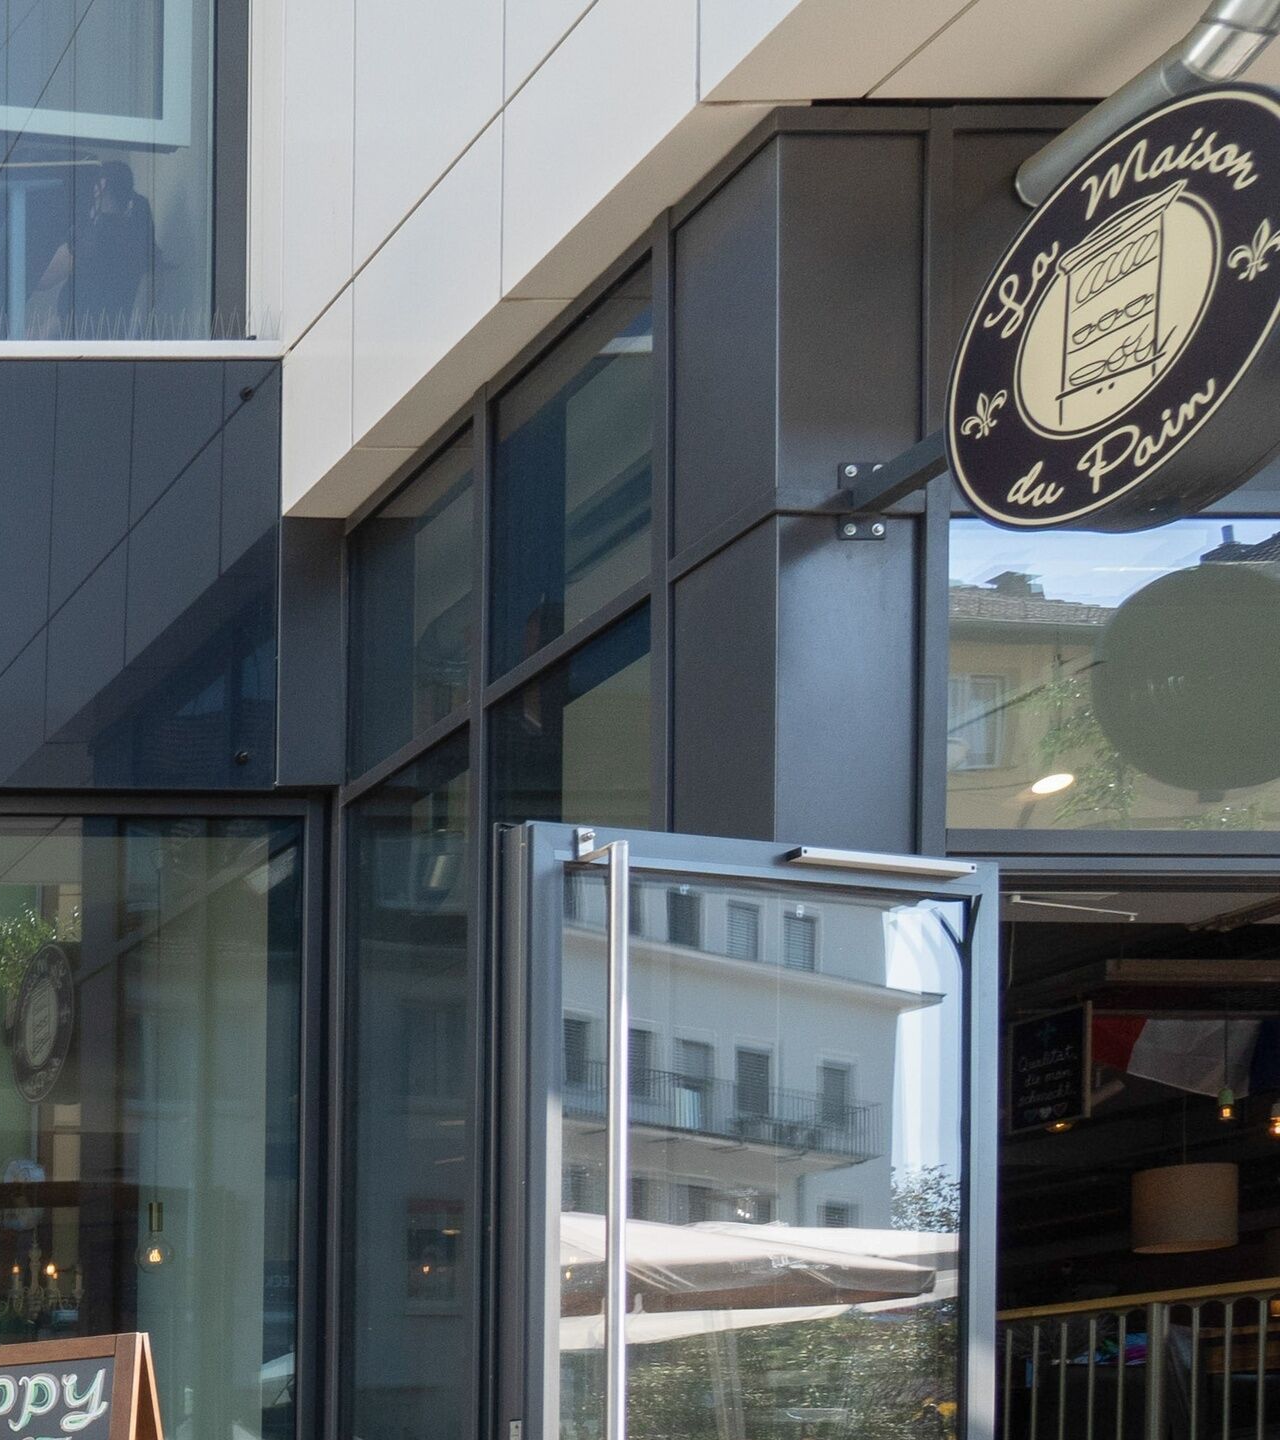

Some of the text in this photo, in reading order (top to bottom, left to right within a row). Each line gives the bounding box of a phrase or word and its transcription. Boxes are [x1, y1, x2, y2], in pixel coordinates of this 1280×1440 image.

[983, 126, 1259, 339] La Maison
[1006, 377, 1216, 507] du Pain
